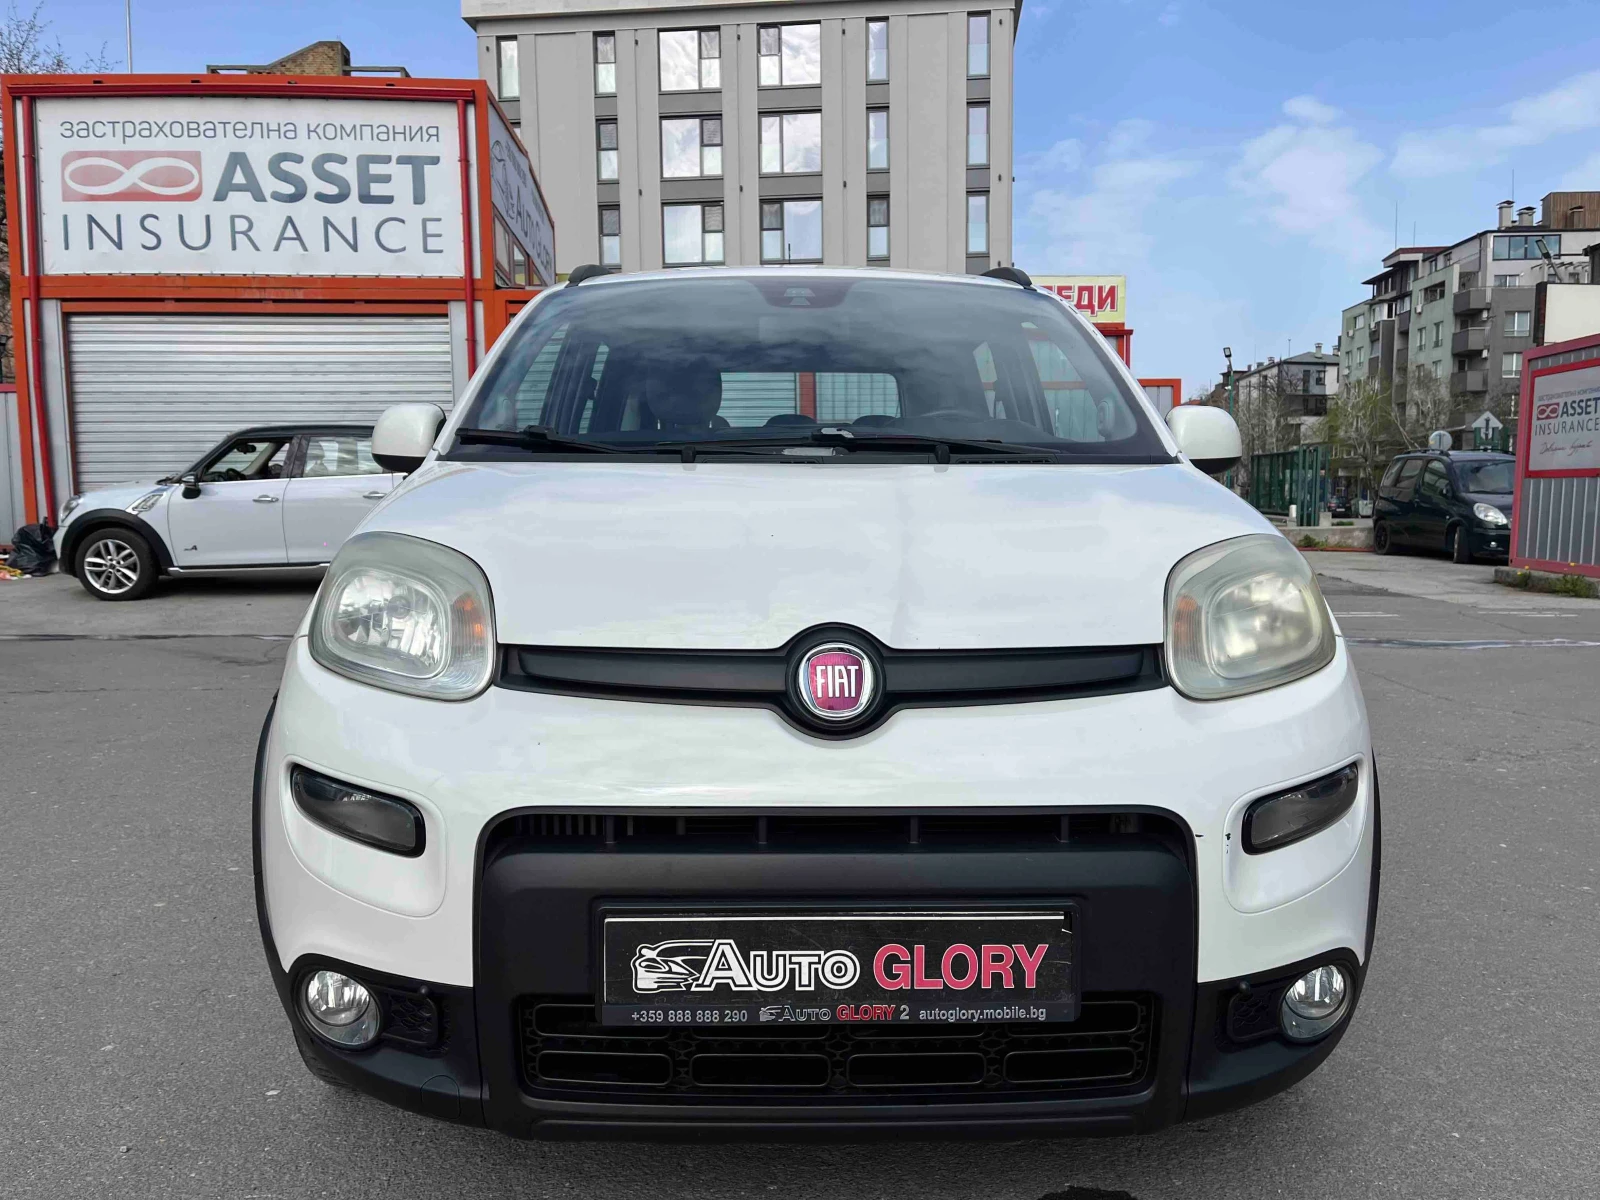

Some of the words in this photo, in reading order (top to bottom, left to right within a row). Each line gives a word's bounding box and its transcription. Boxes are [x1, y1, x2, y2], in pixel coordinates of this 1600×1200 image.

[60, 120, 298, 143] застрахователна
[306, 123, 440, 143] компания
[213, 151, 441, 205] ASSET
[62, 213, 444, 254] INSURANCE
[1040, 285, 1119, 316] ЕДИ
[1560, 397, 1600, 418] ASSET
[1534, 417, 1600, 436] INSURANCE
[815, 665, 859, 698] FIAT
[873, 943, 1049, 991] GLORY
[631, 1010, 664, 1022] +359
[668, 1010, 692, 1022] 888
[696, 1010, 720, 1022] 888
[724, 1010, 748, 1022] 290
[836, 1005, 896, 1021] GLORY
[900, 1005, 910, 1020] 2
[919, 1006, 1047, 1022] autoglory.mobile.bg
